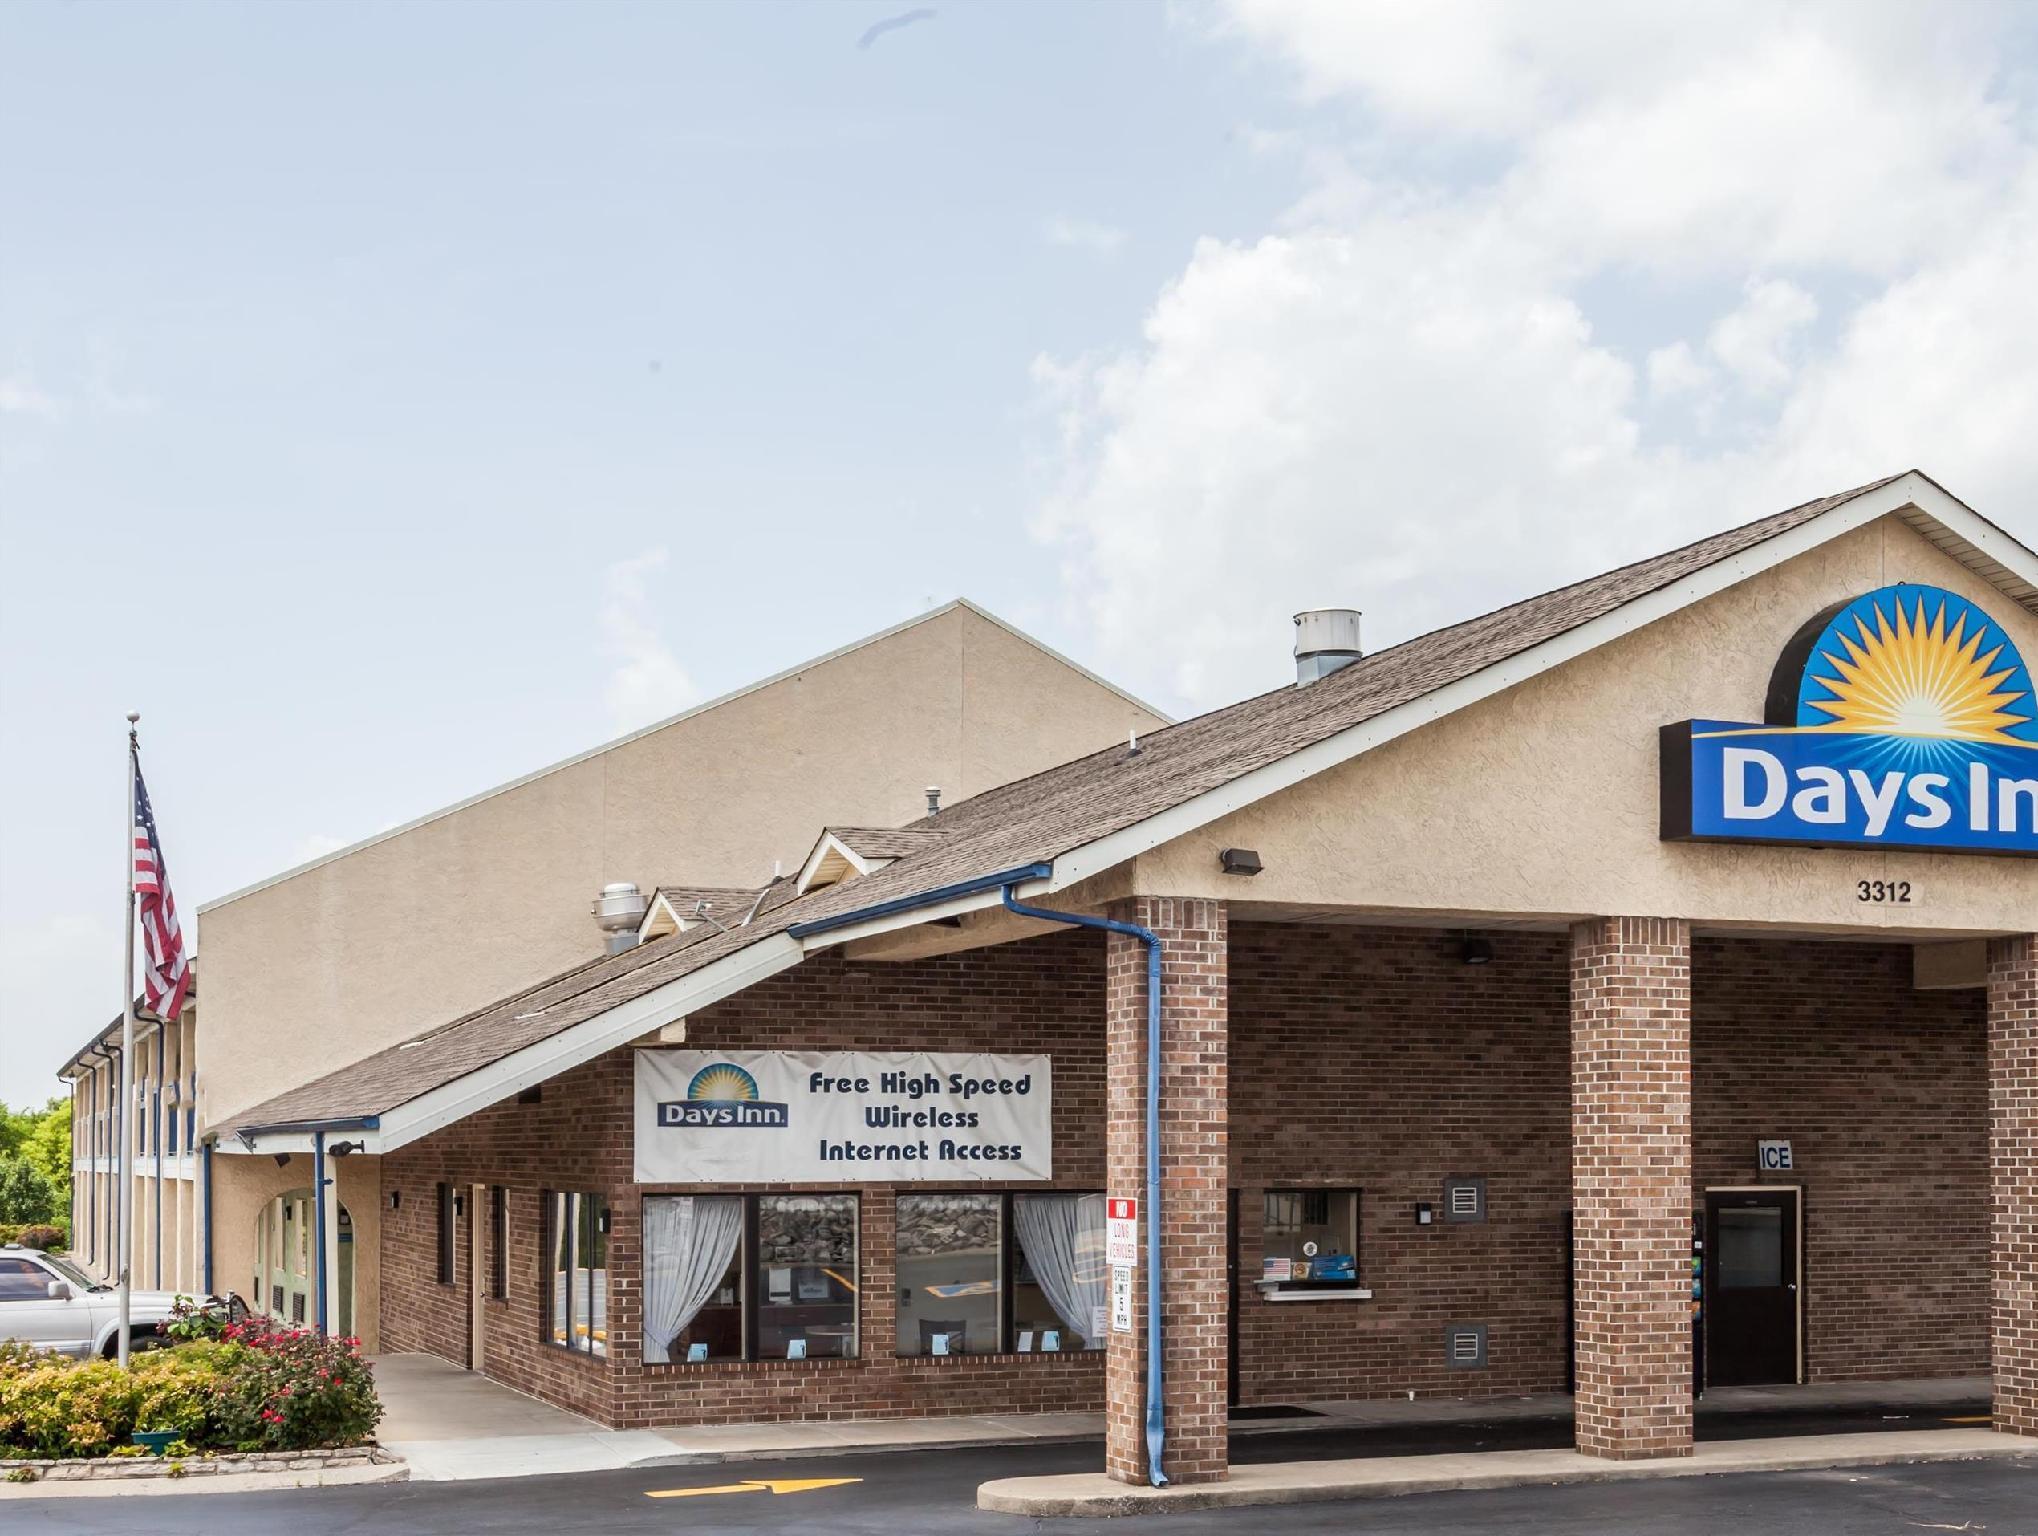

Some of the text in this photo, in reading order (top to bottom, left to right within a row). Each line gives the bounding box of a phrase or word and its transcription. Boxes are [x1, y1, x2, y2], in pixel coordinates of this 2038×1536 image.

[1723, 747, 1952, 837] Days
[1858, 880, 1911, 902] 3312
[809, 1071, 1031, 1099] Free High Speed
[865, 1105, 978, 1128] Wireless
[820, 1139, 1022, 1161] Internet Access
[1760, 1147, 1791, 1168] ICE
[1115, 1200, 1128, 1218] NO
[1114, 1269, 1129, 1282] SPEED
[1116, 1314, 1128, 1326] MPH
